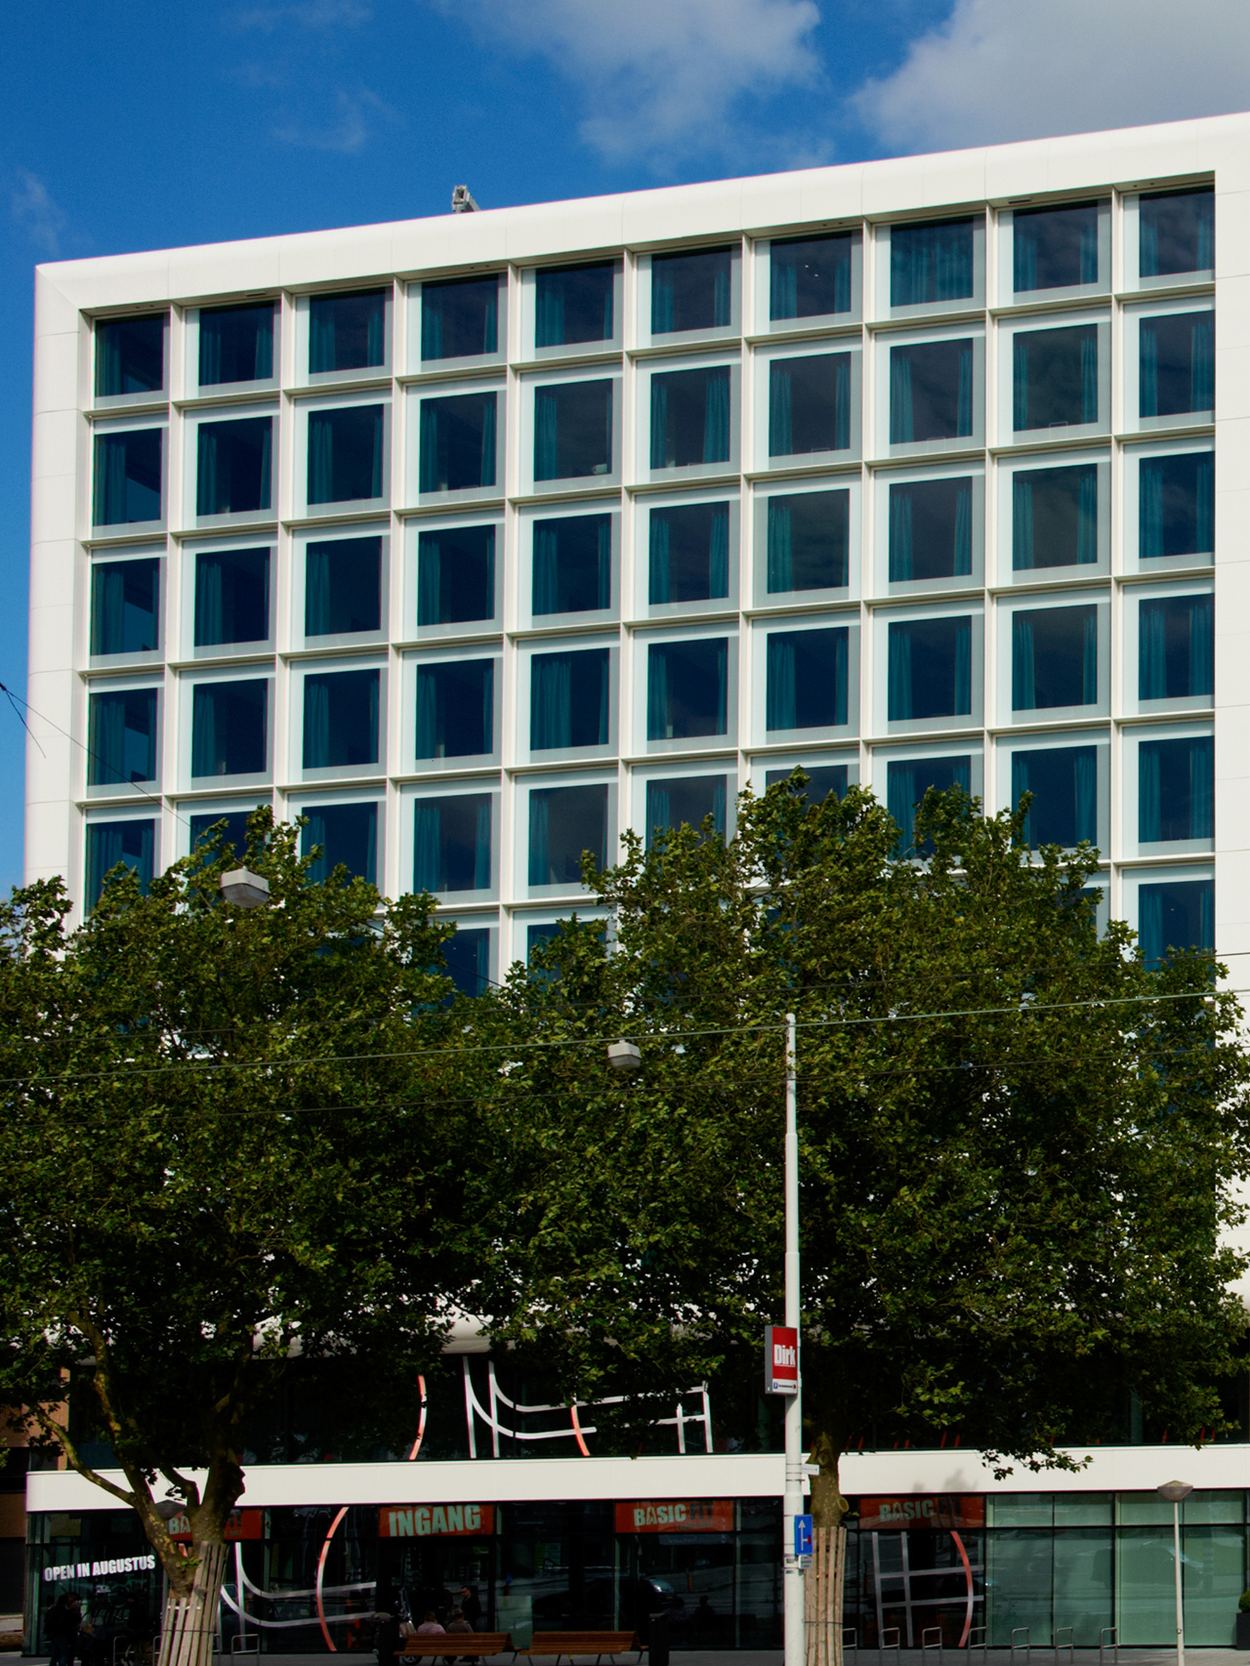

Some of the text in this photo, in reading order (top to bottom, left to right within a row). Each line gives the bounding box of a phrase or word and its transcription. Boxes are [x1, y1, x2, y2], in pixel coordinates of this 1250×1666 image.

[774, 1343, 796, 1367] Dirk
[388, 1504, 481, 1537] INGANG
[634, 1503, 687, 1527] BASIC
[879, 1499, 933, 1521] BASIC
[44, 1555, 156, 1582] OPEN IN AUGUSTUS
